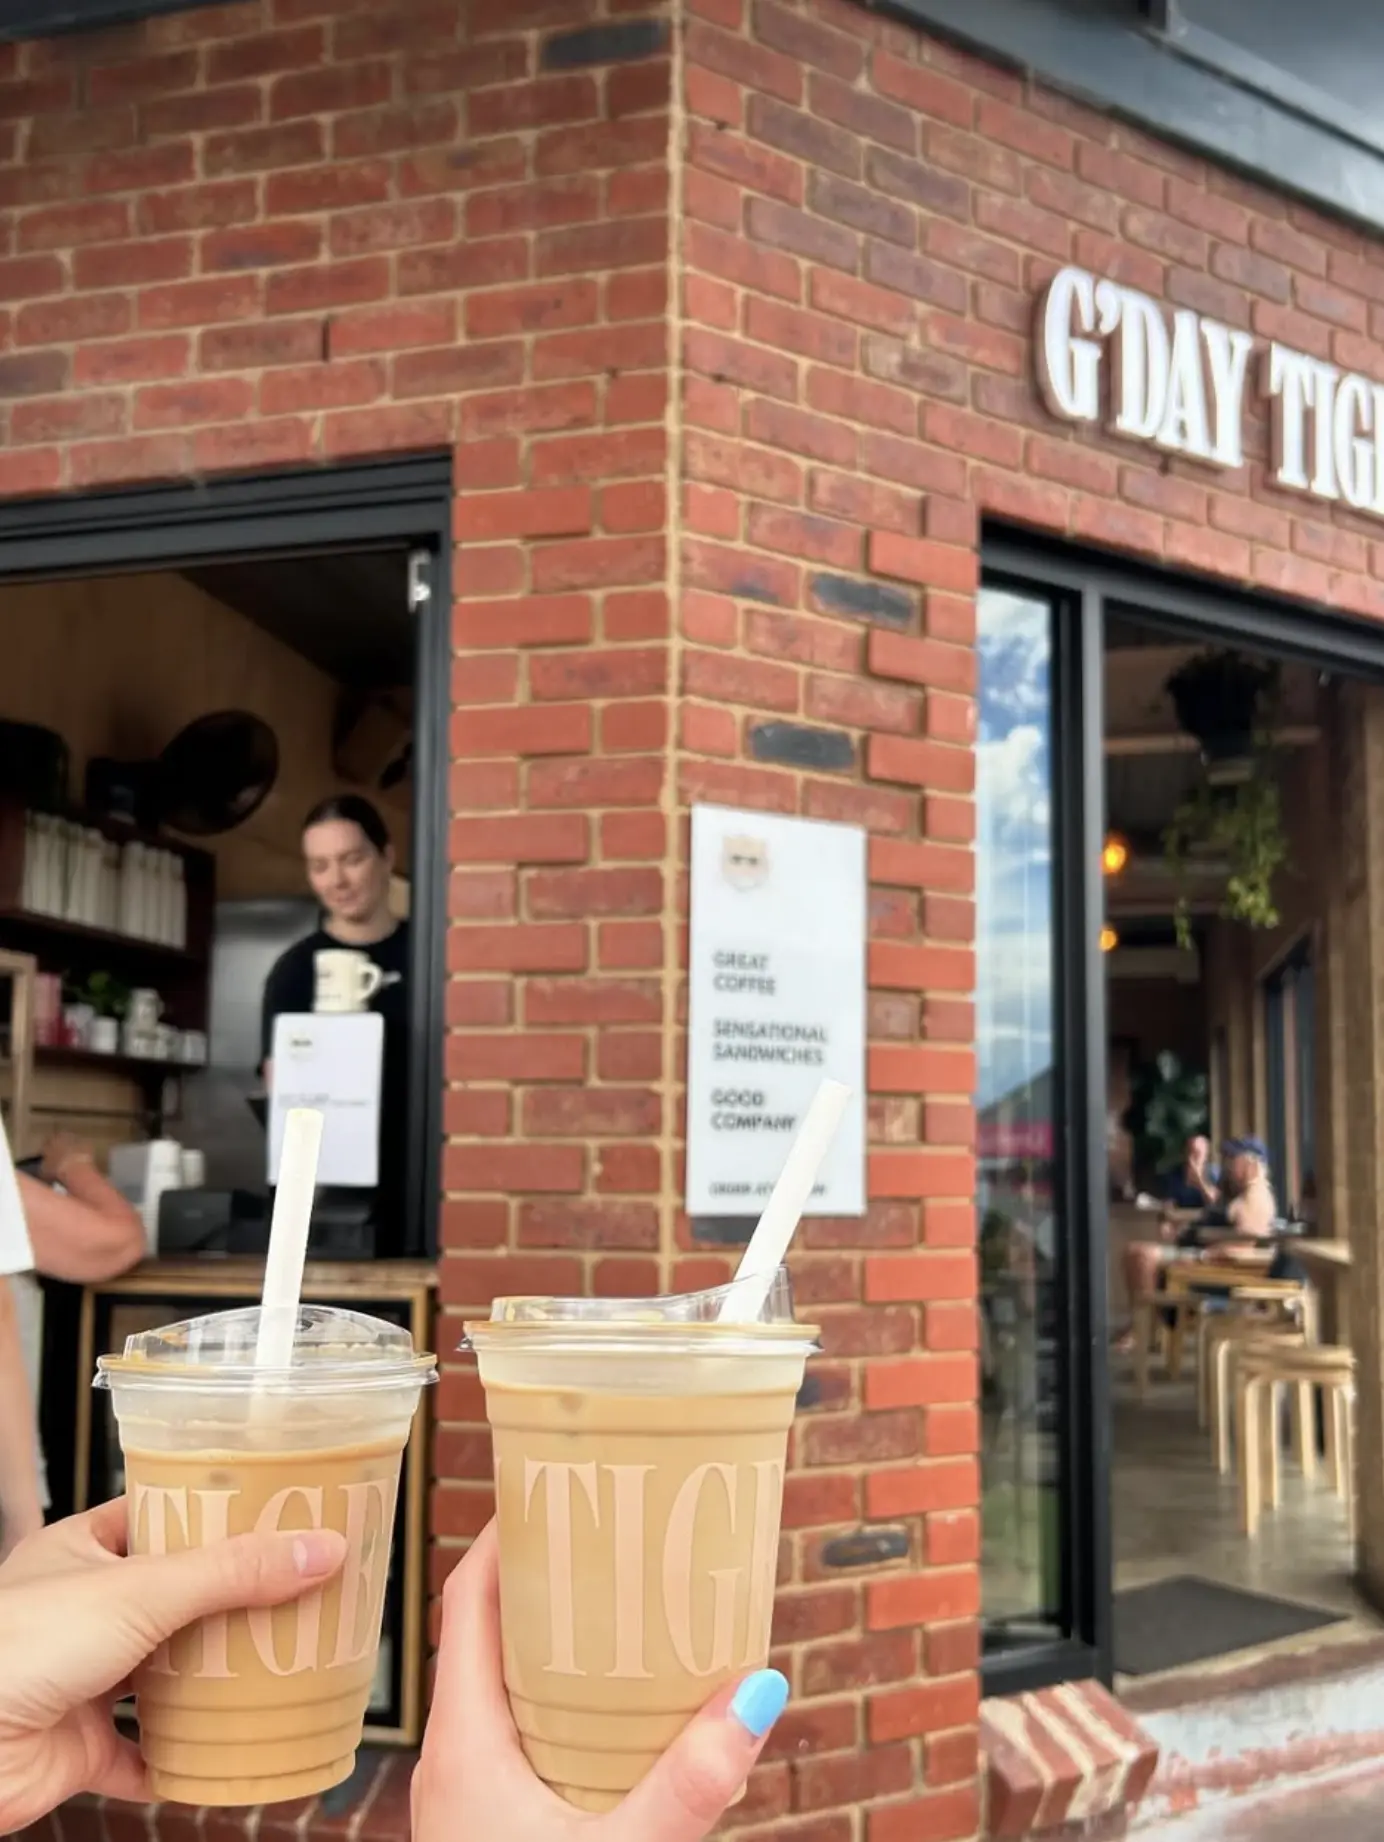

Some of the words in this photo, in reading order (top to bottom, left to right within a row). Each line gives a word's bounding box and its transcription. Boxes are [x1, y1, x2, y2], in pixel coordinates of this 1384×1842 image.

[1043, 265, 1254, 469] G'DAY
[1269, 340, 1384, 516] TIG
[713, 949, 770, 972] GREAT
[713, 974, 776, 996] COFFEE
[713, 1019, 829, 1045] SENSATIONAL
[712, 1043, 825, 1067] SANDWICHES
[711, 1088, 766, 1108] GOOD
[710, 1112, 797, 1132] COMPANY
